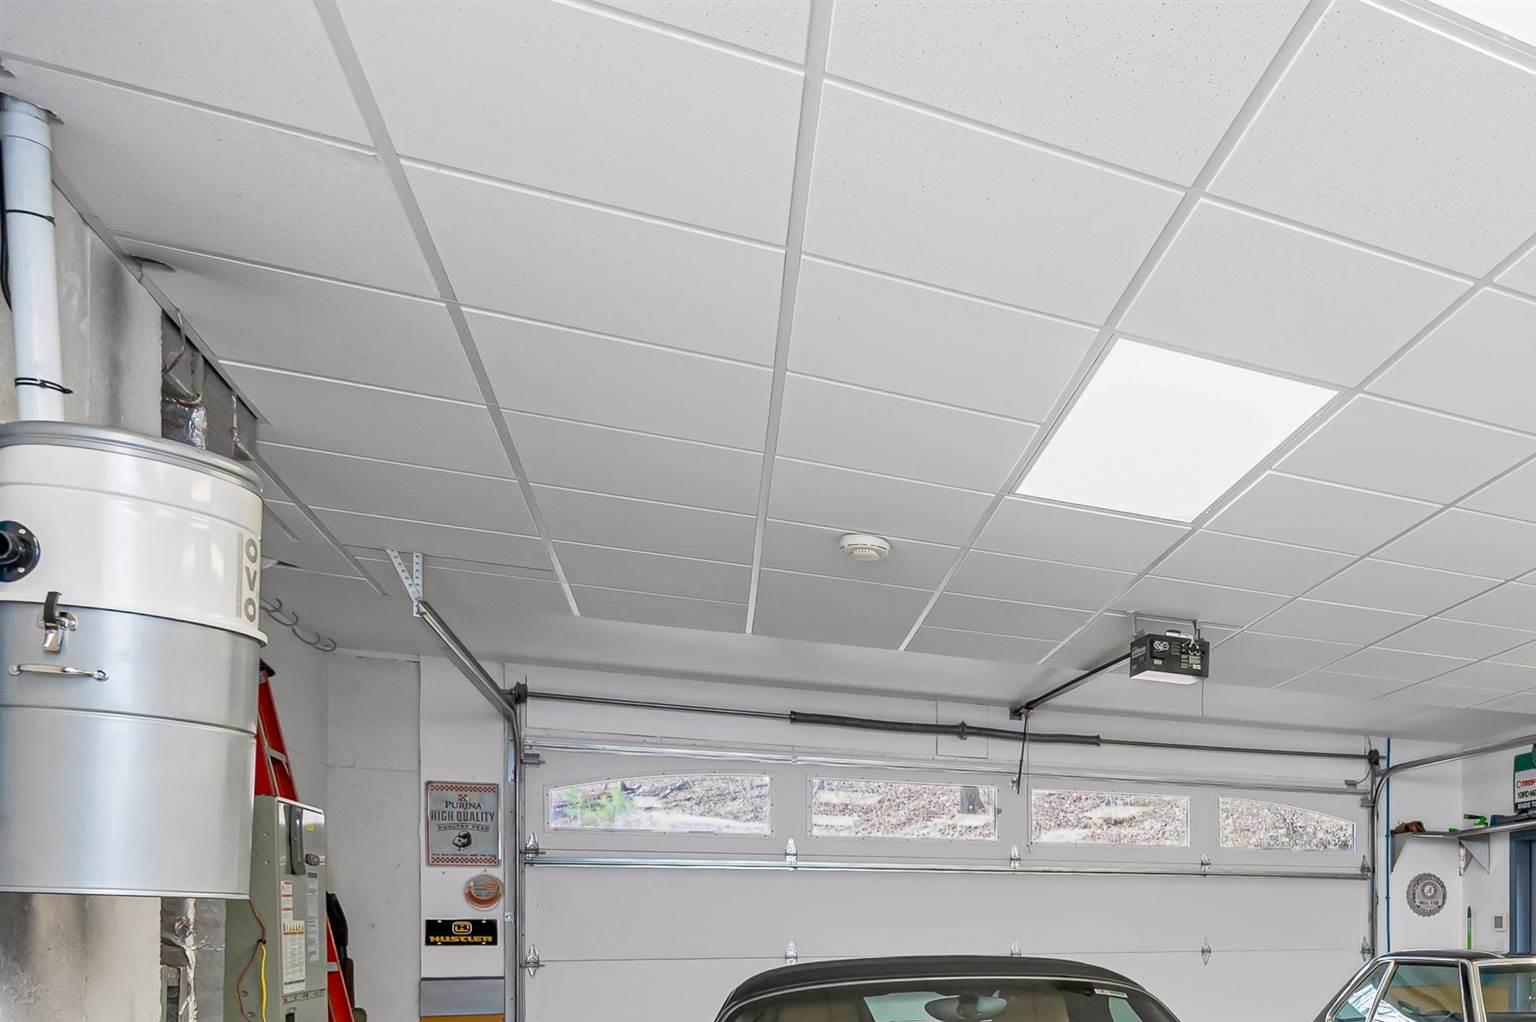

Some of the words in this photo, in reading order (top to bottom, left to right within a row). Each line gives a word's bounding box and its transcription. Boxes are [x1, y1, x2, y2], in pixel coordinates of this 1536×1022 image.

[445, 800, 482, 809] PURINA
[431, 809, 454, 821] HIGH
[456, 810, 495, 822] QUALITY
[429, 935, 493, 943] HUSTLER
